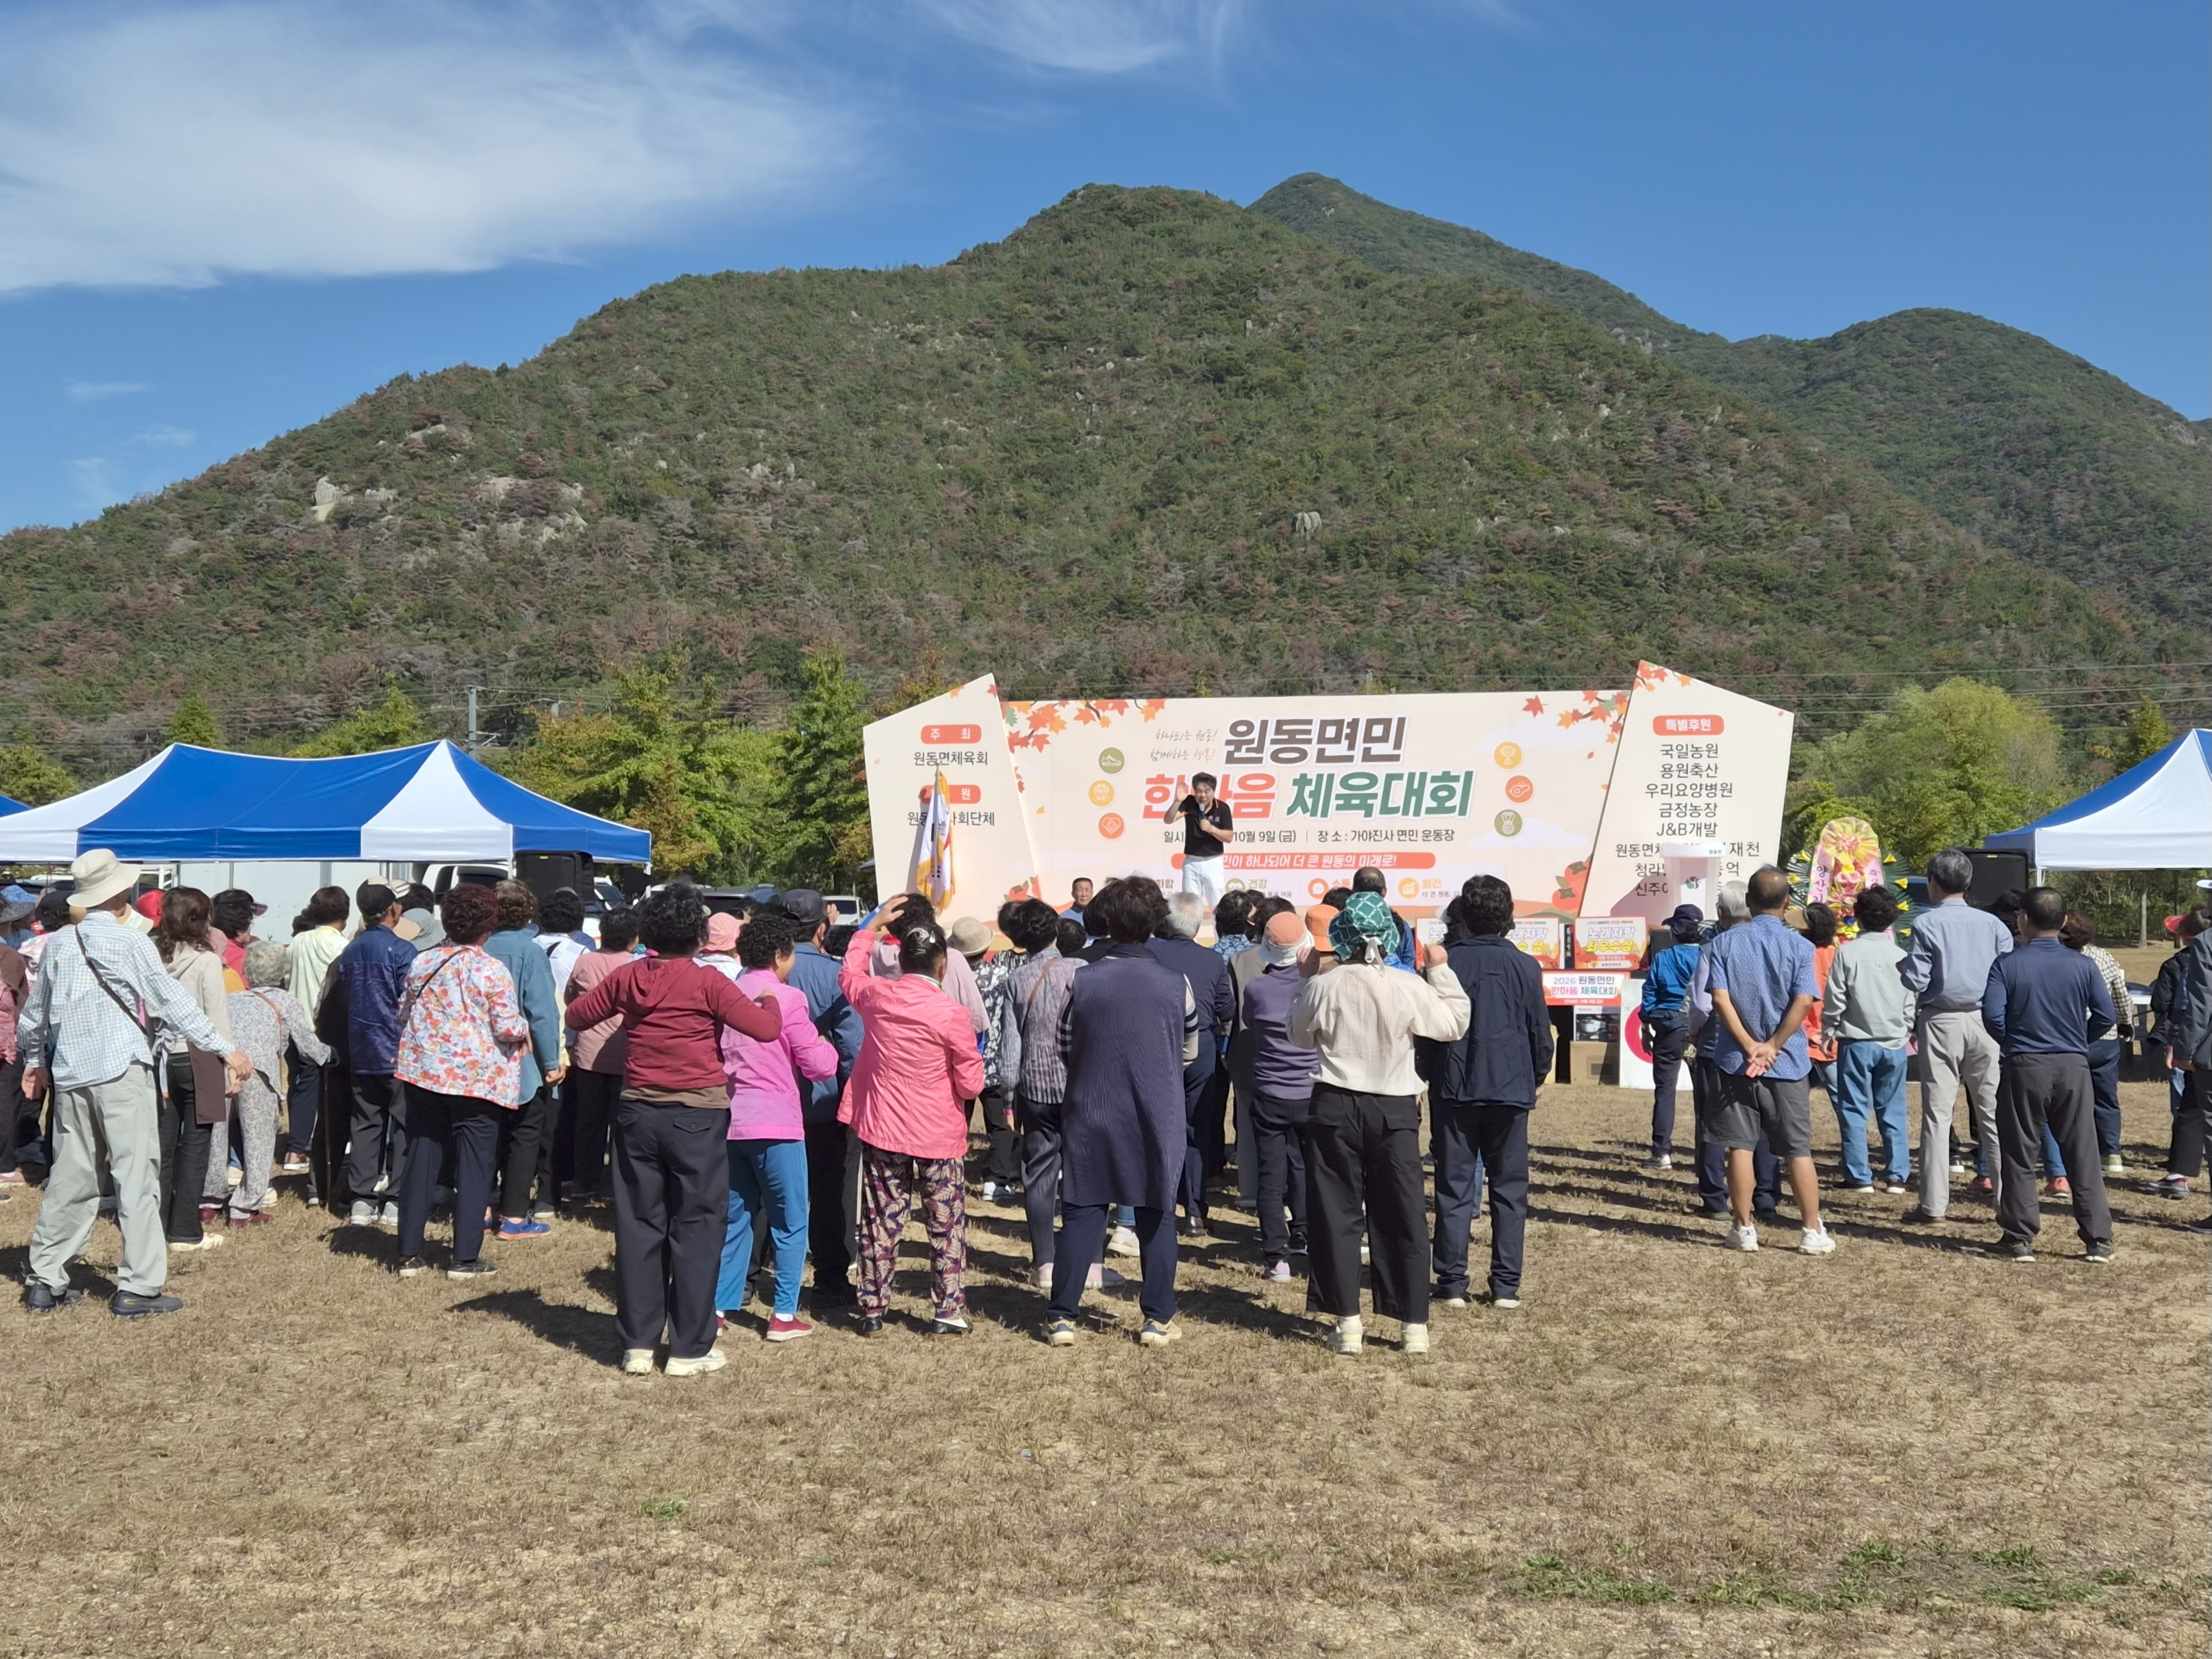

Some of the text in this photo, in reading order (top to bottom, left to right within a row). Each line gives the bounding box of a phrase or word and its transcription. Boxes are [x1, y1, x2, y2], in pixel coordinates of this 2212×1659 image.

[1666, 718, 1712, 731] 특별후원
[931, 728, 971, 740] 주 최
[1155, 729, 1218, 742] 하나되는 원동!
[1224, 717, 1406, 764] 원동면민
[1150, 748, 1190, 761] 함께하는
[1660, 743, 1719, 759] 국일농원
[913, 751, 988, 766] 원동면체육회
[1660, 763, 1719, 779] 용원축산
[961, 788, 971, 800] 원
[1286, 770, 1474, 818] 체육대회
[1645, 782, 1733, 799] 우리요양병원
[1659, 802, 1718, 818] 금정농장
[1351, 830, 1394, 842] 가야진사
[1397, 830, 1418, 842] 면민
[1422, 830, 1455, 841] 운동장
[1657, 822, 1718, 837] J&B개발
[1259, 831, 1276, 843] 9일
[1279, 830, 1296, 843] (금)
[1245, 854, 1291, 868] 하나되어
[1293, 855, 1305, 868] 더
[1307, 855, 1319, 868] 큰
[1322, 854, 1357, 868] 원동의
[1358, 854, 1397, 868] 미래로!
[1505, 927, 1548, 940] 래자랑
[1588, 927, 1636, 940] 노래자랑
[1585, 940, 1634, 952] 최우수상
[1551, 986, 1617, 995] 한마음 체육대회
